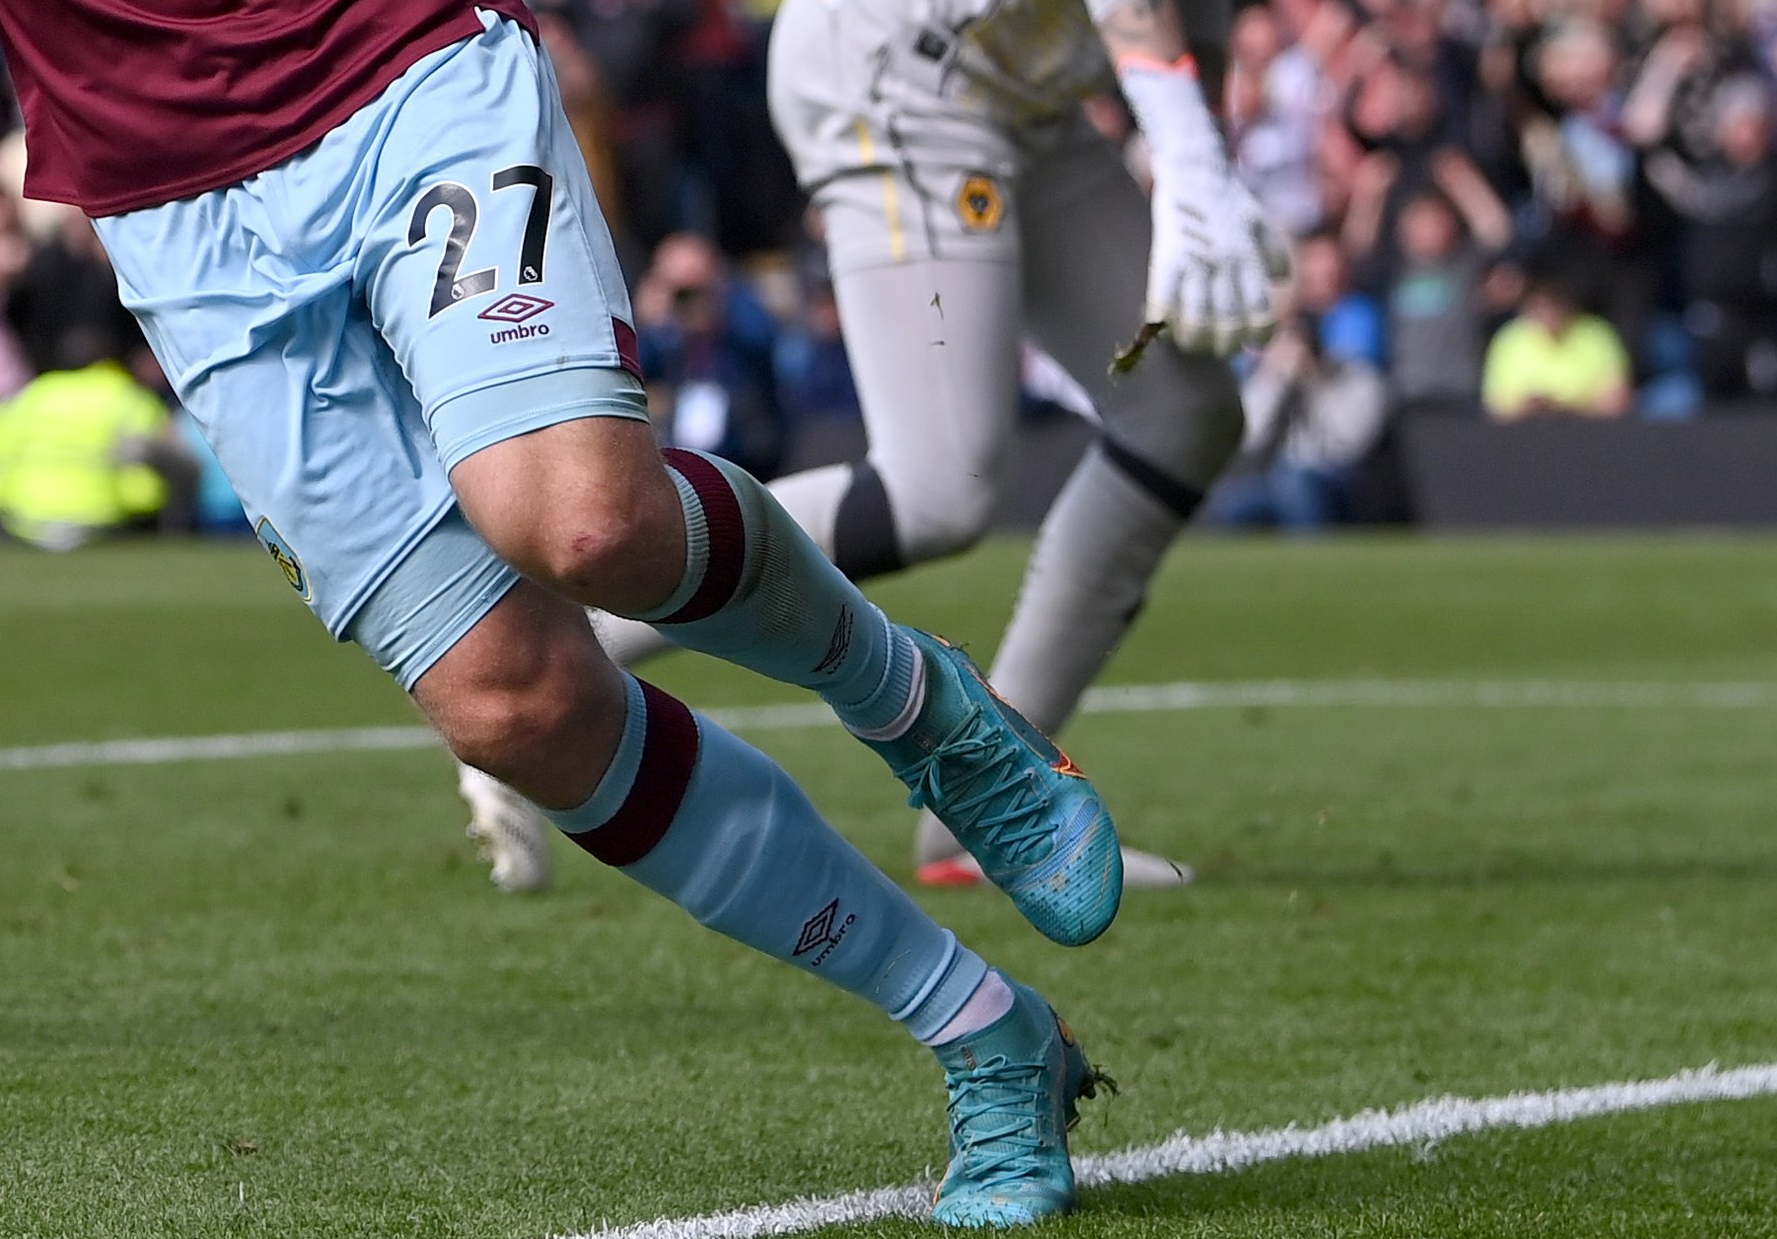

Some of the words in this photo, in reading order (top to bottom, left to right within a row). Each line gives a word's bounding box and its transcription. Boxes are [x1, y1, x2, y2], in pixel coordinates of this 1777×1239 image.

[407, 164, 554, 321] 27
[490, 321, 550, 345] umbro
[810, 912, 857, 967] umbro
